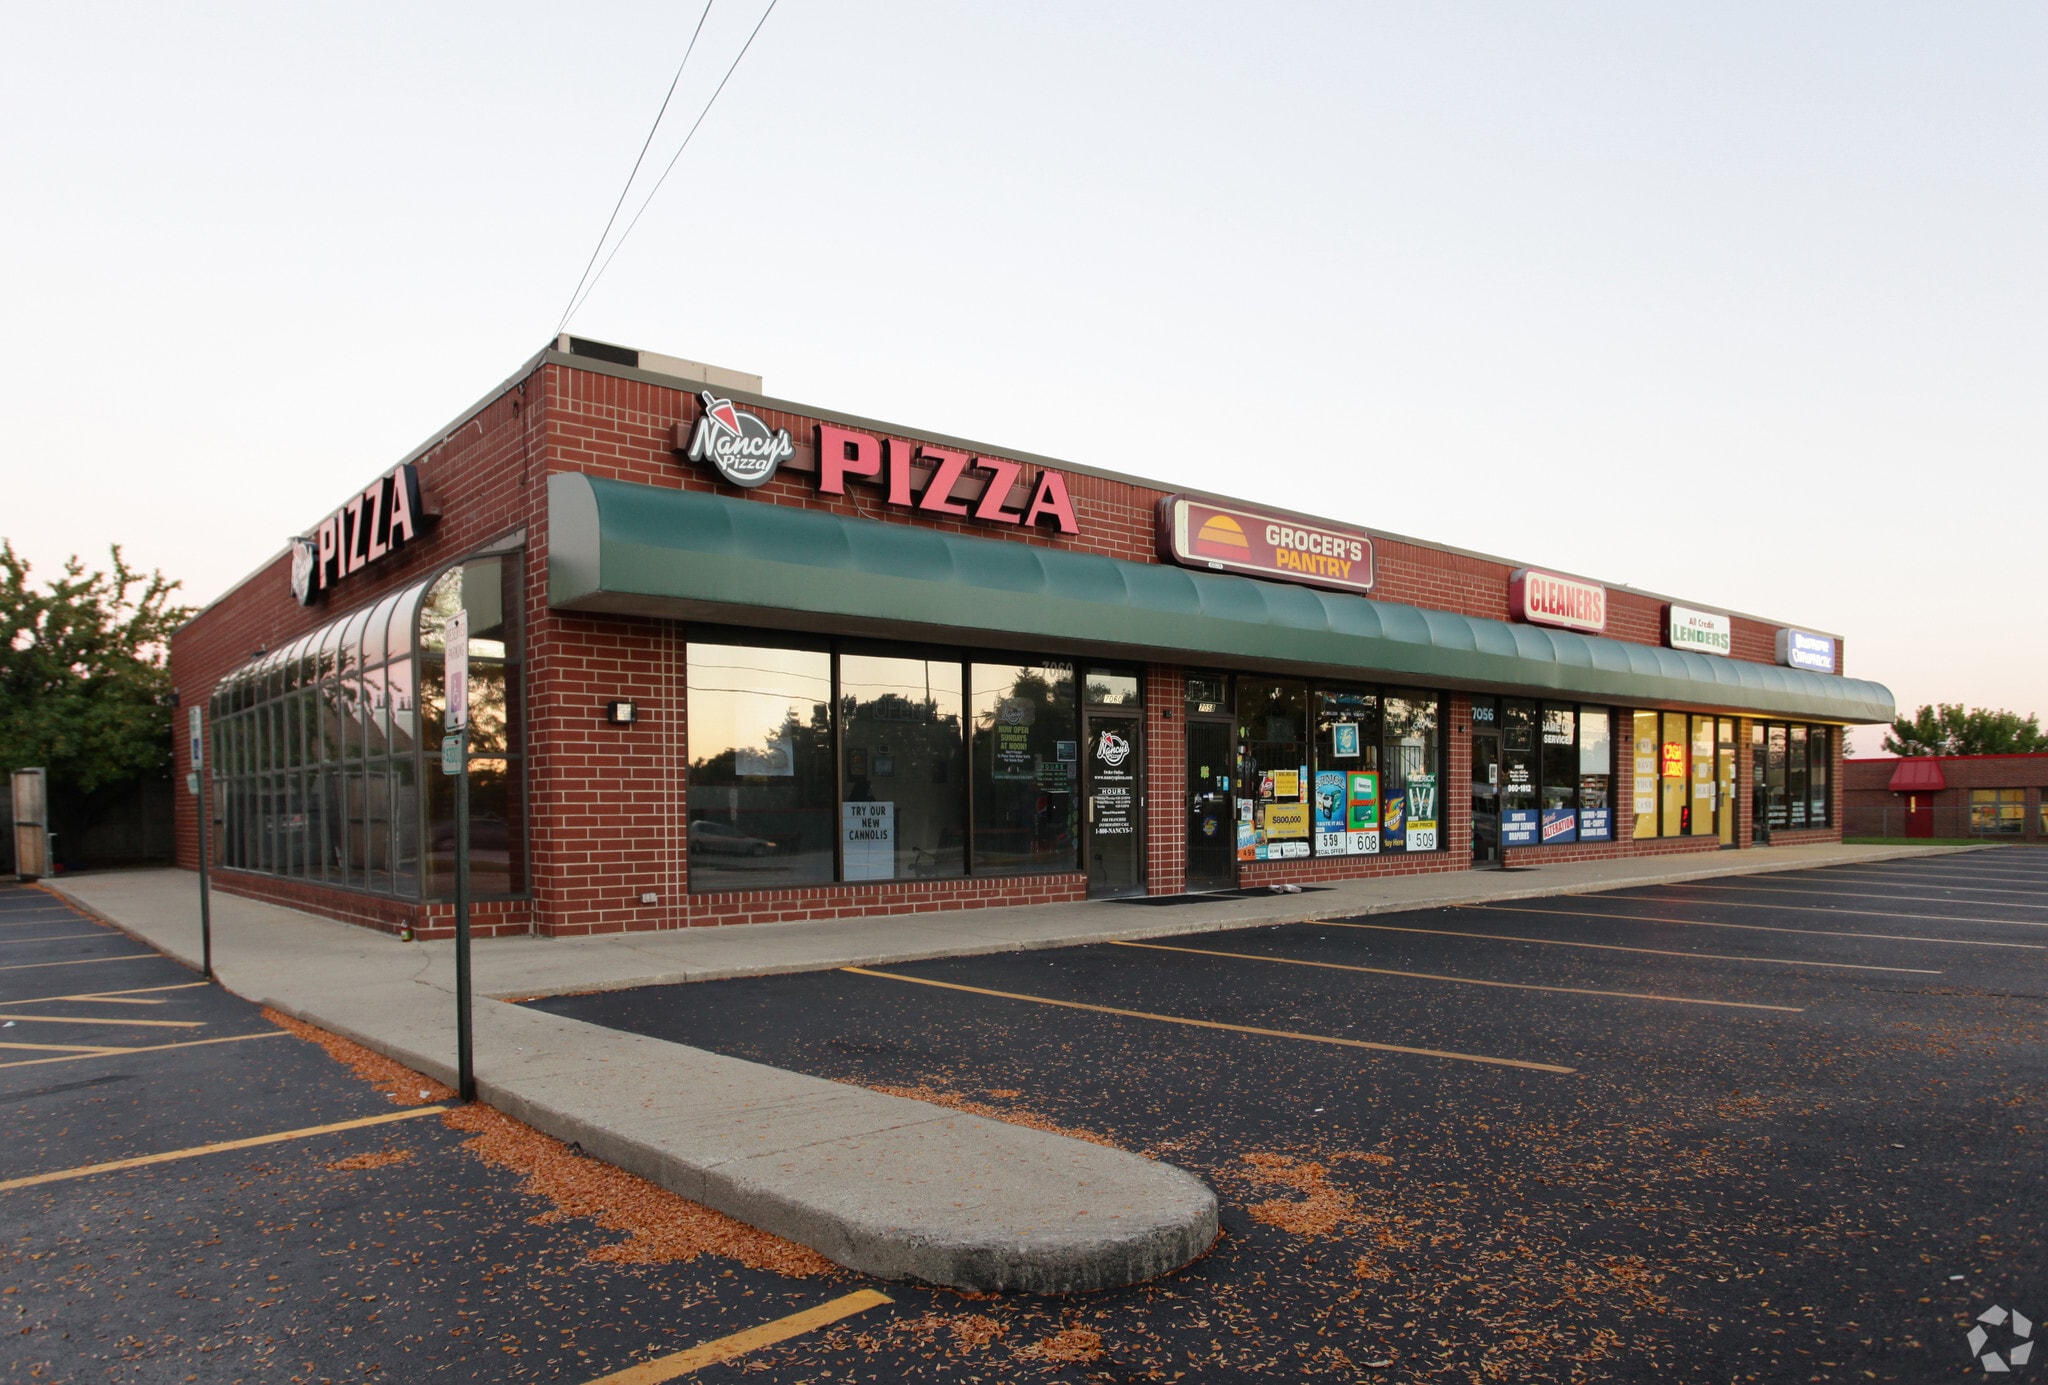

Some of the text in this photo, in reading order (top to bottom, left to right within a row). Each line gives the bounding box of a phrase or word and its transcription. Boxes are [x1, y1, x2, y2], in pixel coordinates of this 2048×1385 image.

[691, 418, 793, 469] Nancy's
[722, 454, 768, 470] Pizza
[818, 424, 1081, 535] PIZZA
[318, 463, 415, 590] PIZZA
[1266, 524, 1362, 562] GROCER'S
[1276, 547, 1352, 579] PANTRY
[1530, 577, 1602, 624] CLEANERS
[1689, 617, 1715, 629] All Credit
[1673, 622, 1729, 651] LENDERS
[448, 643, 465, 662] PARKING
[1041, 660, 1074, 681] 7060
[1105, 694, 1123, 703] 7060
[1471, 707, 1494, 720] 7056
[999, 725, 1030, 735] NOW OPEN
[1542, 721, 1560, 733] SAME
[1000, 734, 1028, 743] SUNDAYS
[1000, 742, 1008, 750] AT
[1664, 743, 1682, 760] CASH
[1662, 760, 1684, 777] LOANS
[851, 806, 886, 817] TRY OUR
[861, 817, 880, 829] NEW
[1272, 815, 1301, 825] $800,000
[1543, 817, 1575, 838] ALTERATION
[849, 829, 888, 841] CANNOLIS
[1315, 848, 1330, 856] PECIAL
